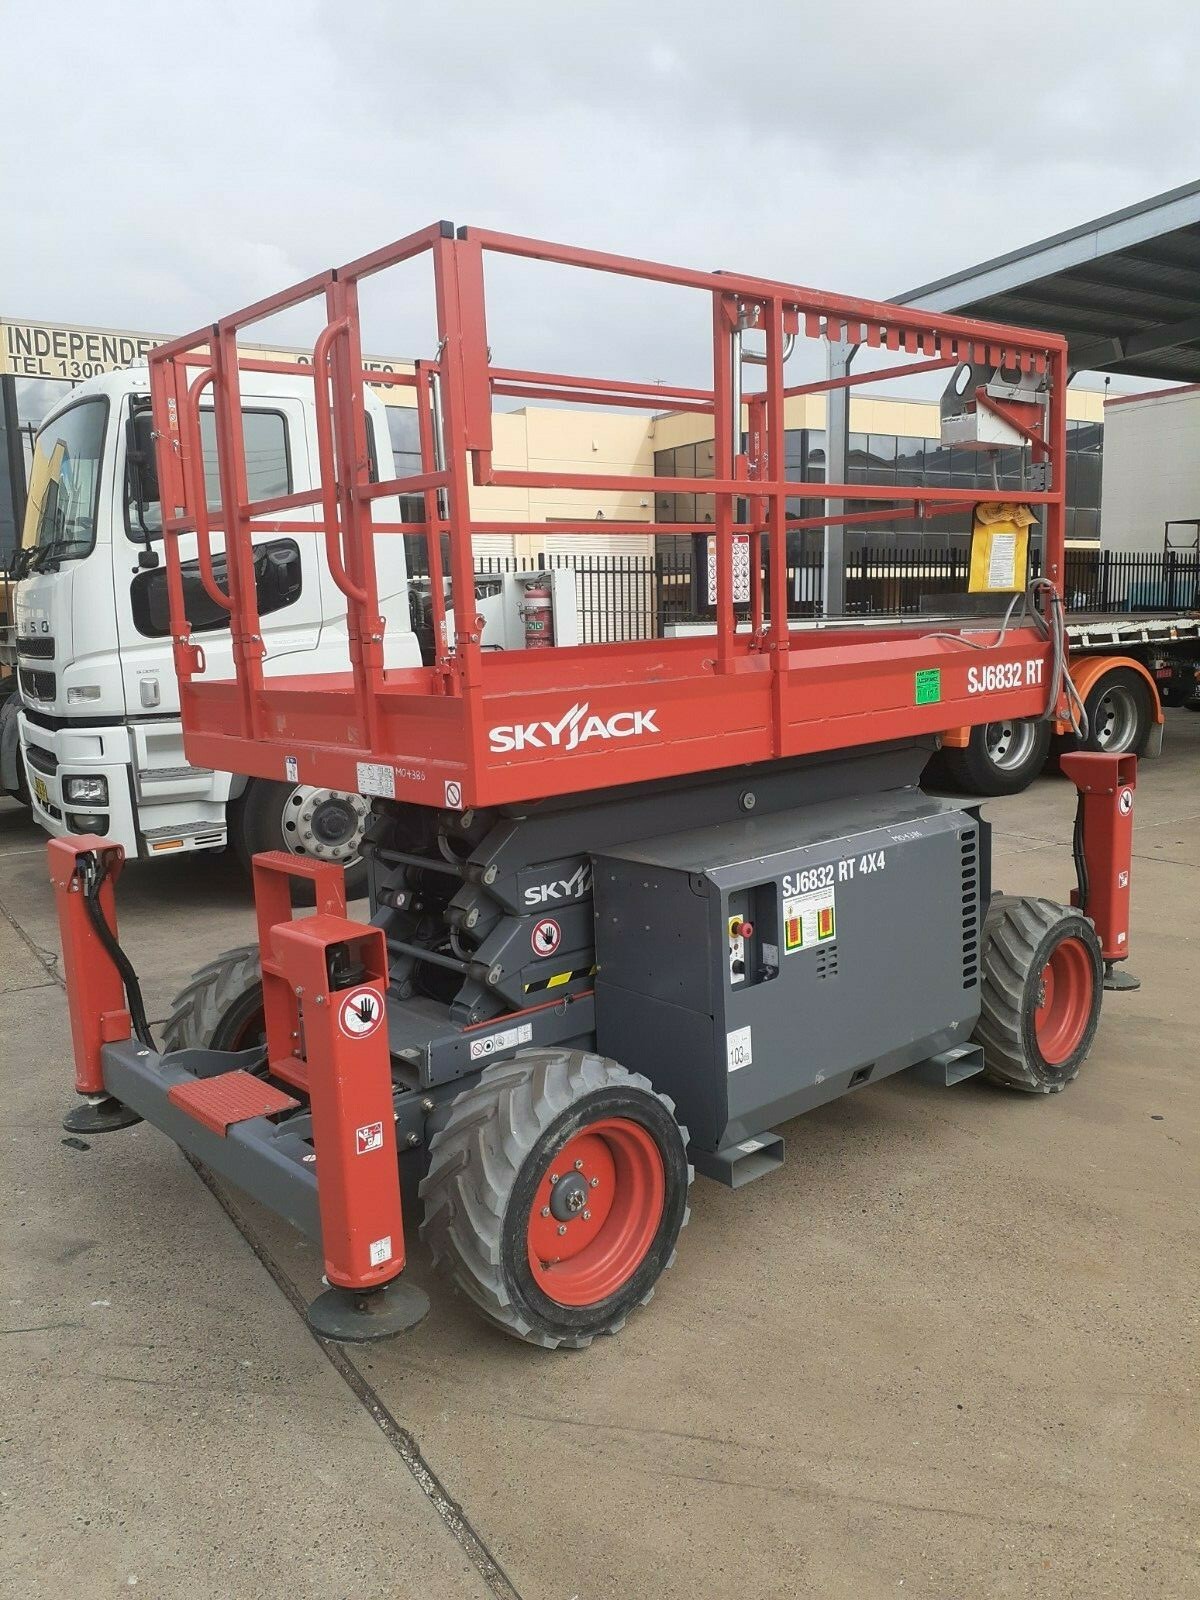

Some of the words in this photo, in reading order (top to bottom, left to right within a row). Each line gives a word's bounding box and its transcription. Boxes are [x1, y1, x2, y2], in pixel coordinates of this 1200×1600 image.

[7, 326, 163, 365] INDEPENDE
[8, 355, 51, 375] TEL
[967, 662, 1022, 693] SJ6832
[1026, 658, 1044, 685] RT
[488, 702, 661, 753] SKYJACK
[782, 864, 835, 897] SJ6832
[838, 858, 856, 882] RT
[859, 850, 886, 875] 4X4
[730, 1045, 744, 1066] 103
